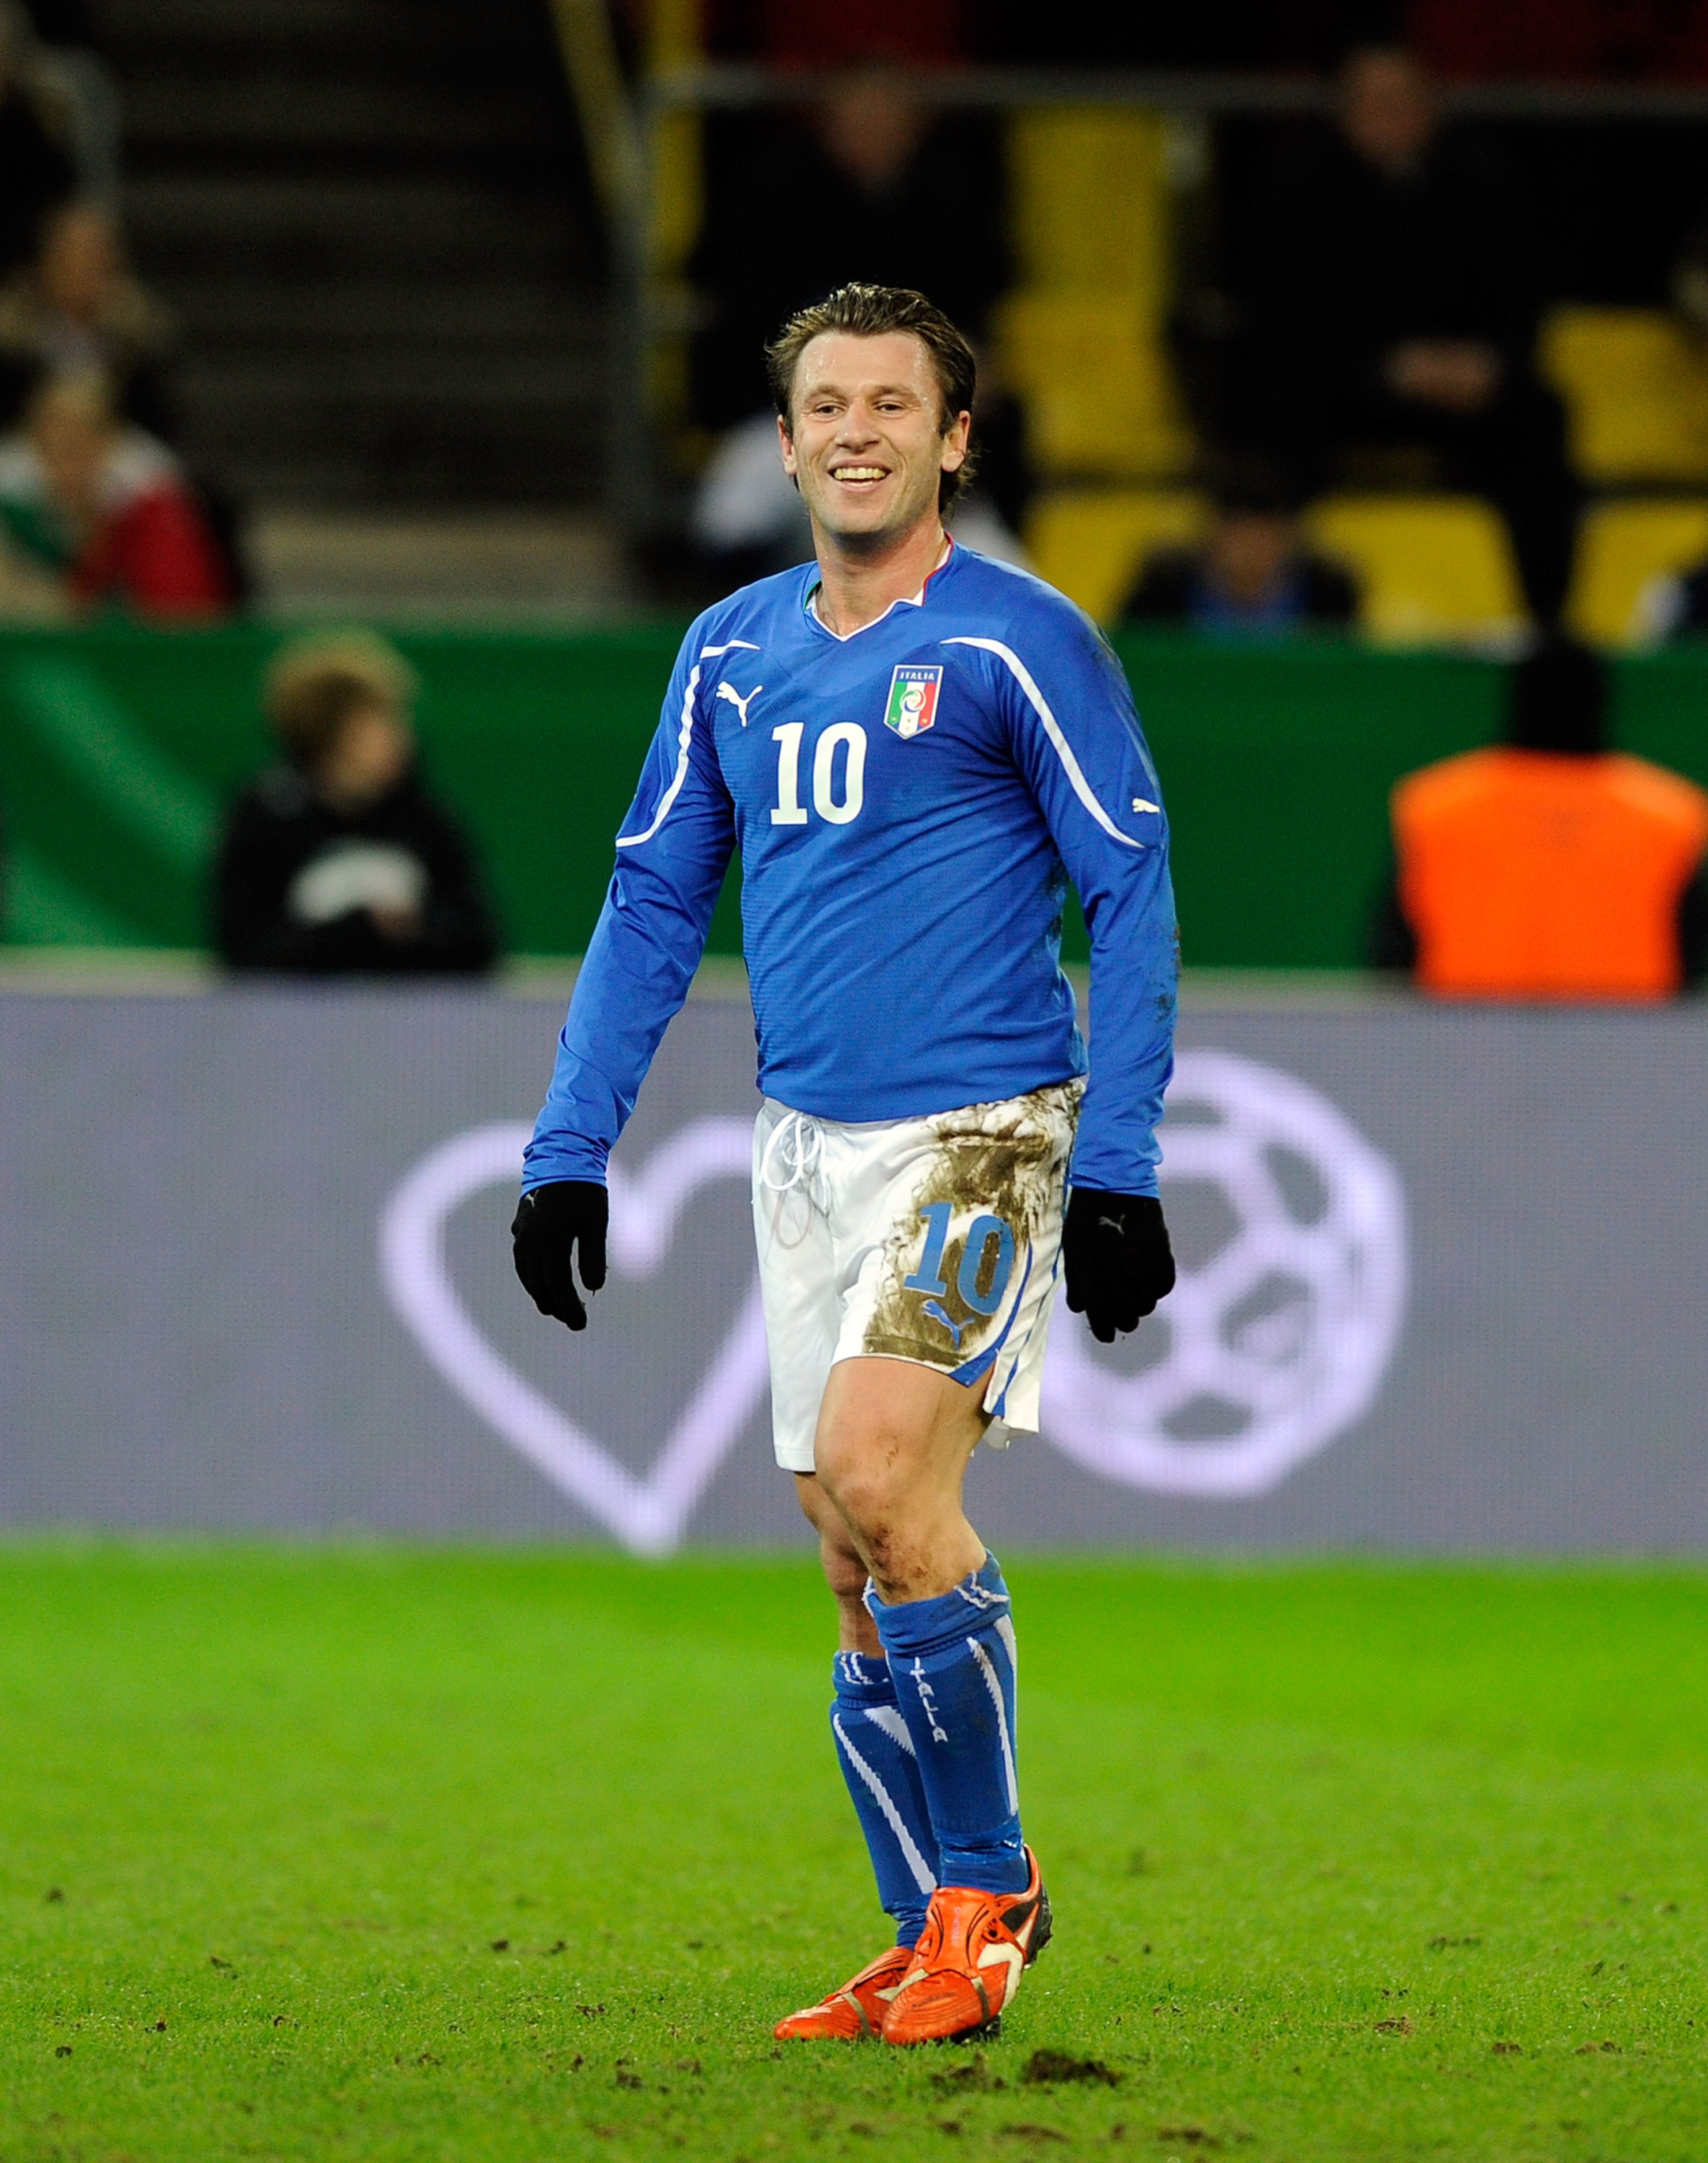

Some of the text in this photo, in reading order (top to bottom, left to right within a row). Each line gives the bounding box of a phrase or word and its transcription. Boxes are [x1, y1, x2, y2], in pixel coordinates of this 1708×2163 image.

[900, 672, 935, 681] ITALIA
[770, 722, 867, 825] 10
[905, 1203, 1015, 1315] 10
[910, 1656, 949, 1742] ITALIA
